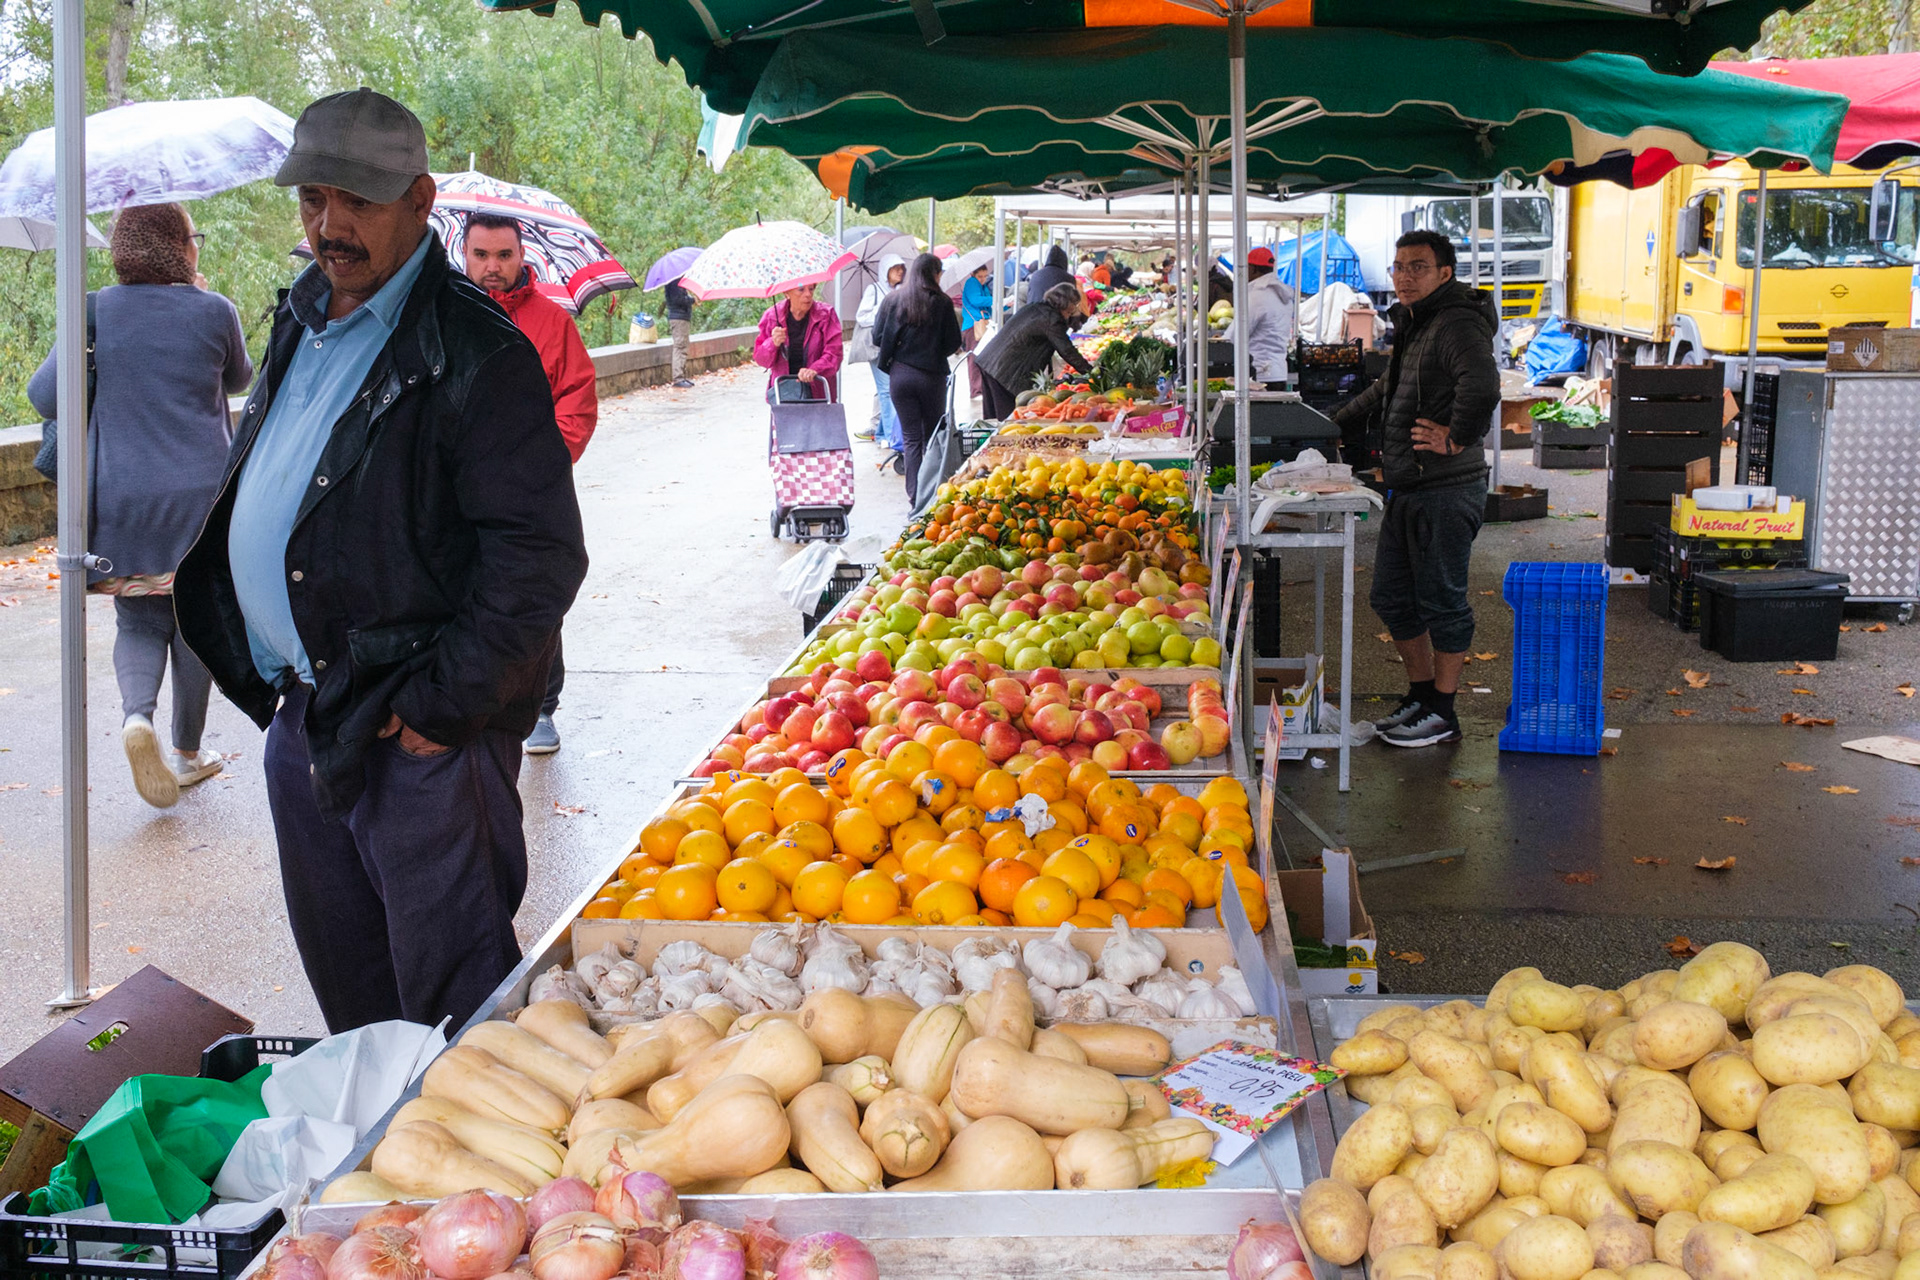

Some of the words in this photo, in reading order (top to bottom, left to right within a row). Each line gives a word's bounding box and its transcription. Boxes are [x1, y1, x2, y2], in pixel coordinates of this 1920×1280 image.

[1688, 515, 1750, 531] Natural
[1753, 518, 1795, 535] Fruit
[1229, 1078, 1284, 1098] 0,95
